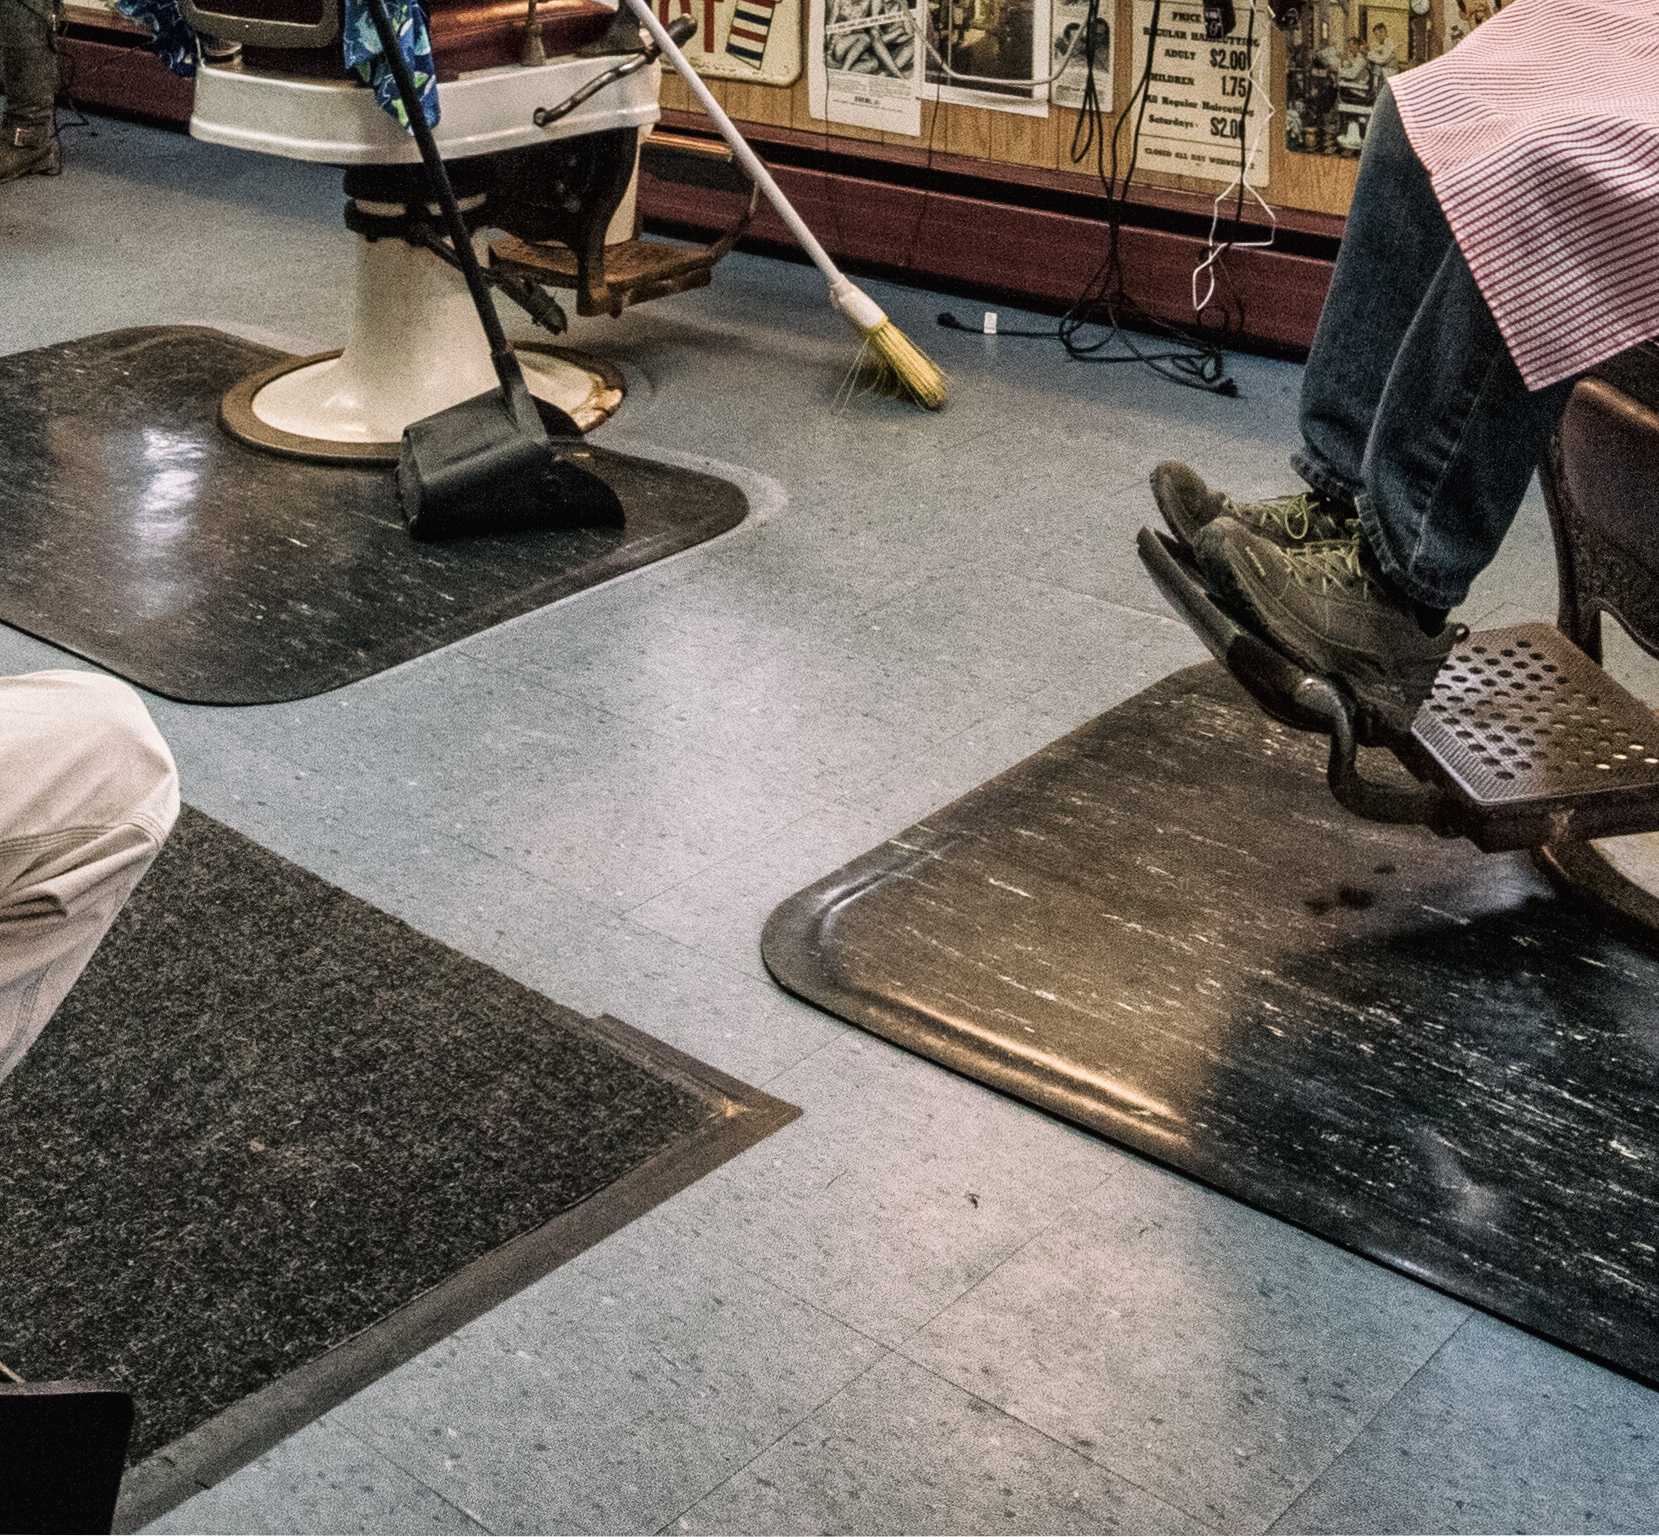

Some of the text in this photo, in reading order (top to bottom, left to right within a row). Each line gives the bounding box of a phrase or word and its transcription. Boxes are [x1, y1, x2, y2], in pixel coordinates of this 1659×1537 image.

[1171, 11, 1203, 24] PRICE
[1142, 26, 1188, 41] RGULAR
[1163, 48, 1248, 71] ADULT $2.00
[1220, 74, 1247, 98] 1.75
[1161, 96, 1199, 111] Regular
[1201, 102, 1255, 118] Haircuttig
